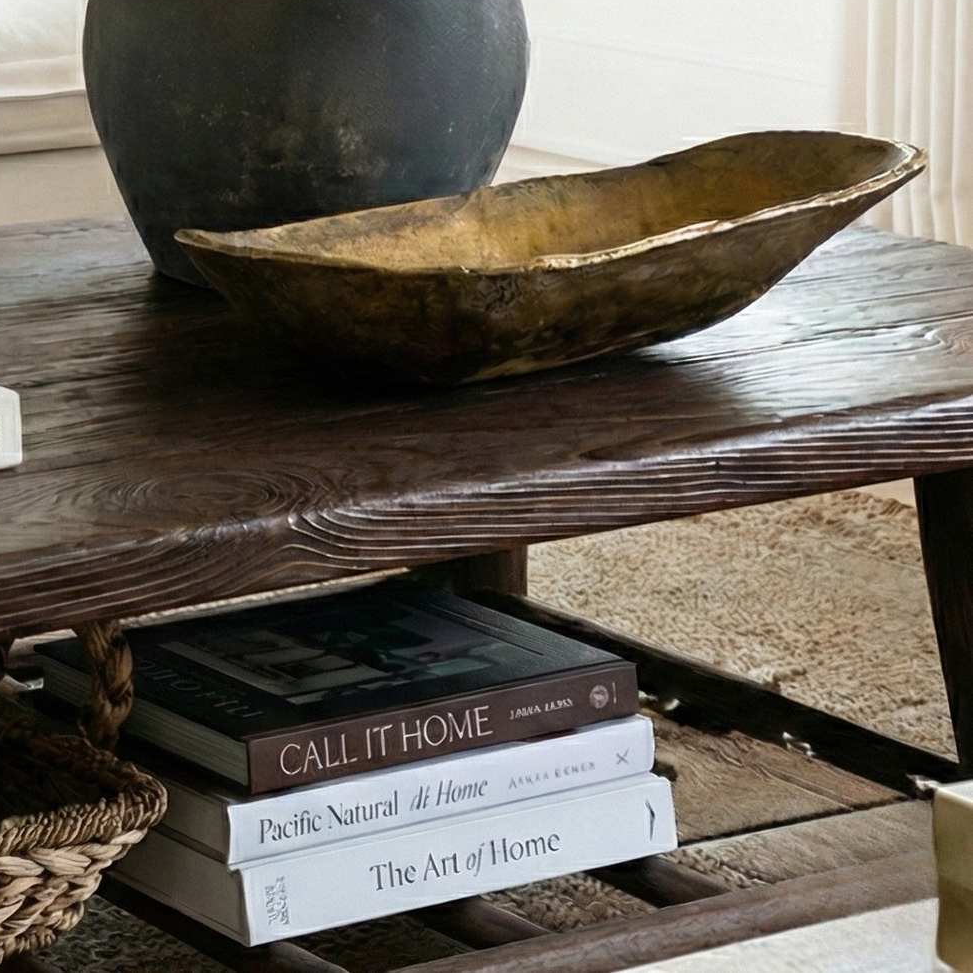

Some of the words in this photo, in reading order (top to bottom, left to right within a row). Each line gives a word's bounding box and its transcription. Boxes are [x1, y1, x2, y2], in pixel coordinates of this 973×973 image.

[280, 733, 358, 775] CALL
[366, 724, 393, 759] IT
[401, 705, 493, 752] HOME
[259, 810, 322, 844] Pacific
[327, 790, 398, 829] Natural
[436, 779, 488, 807] Home
[369, 861, 416, 891] The
[423, 852, 460, 881] Art
[466, 842, 485, 877] of
[490, 833, 560, 866] Home
